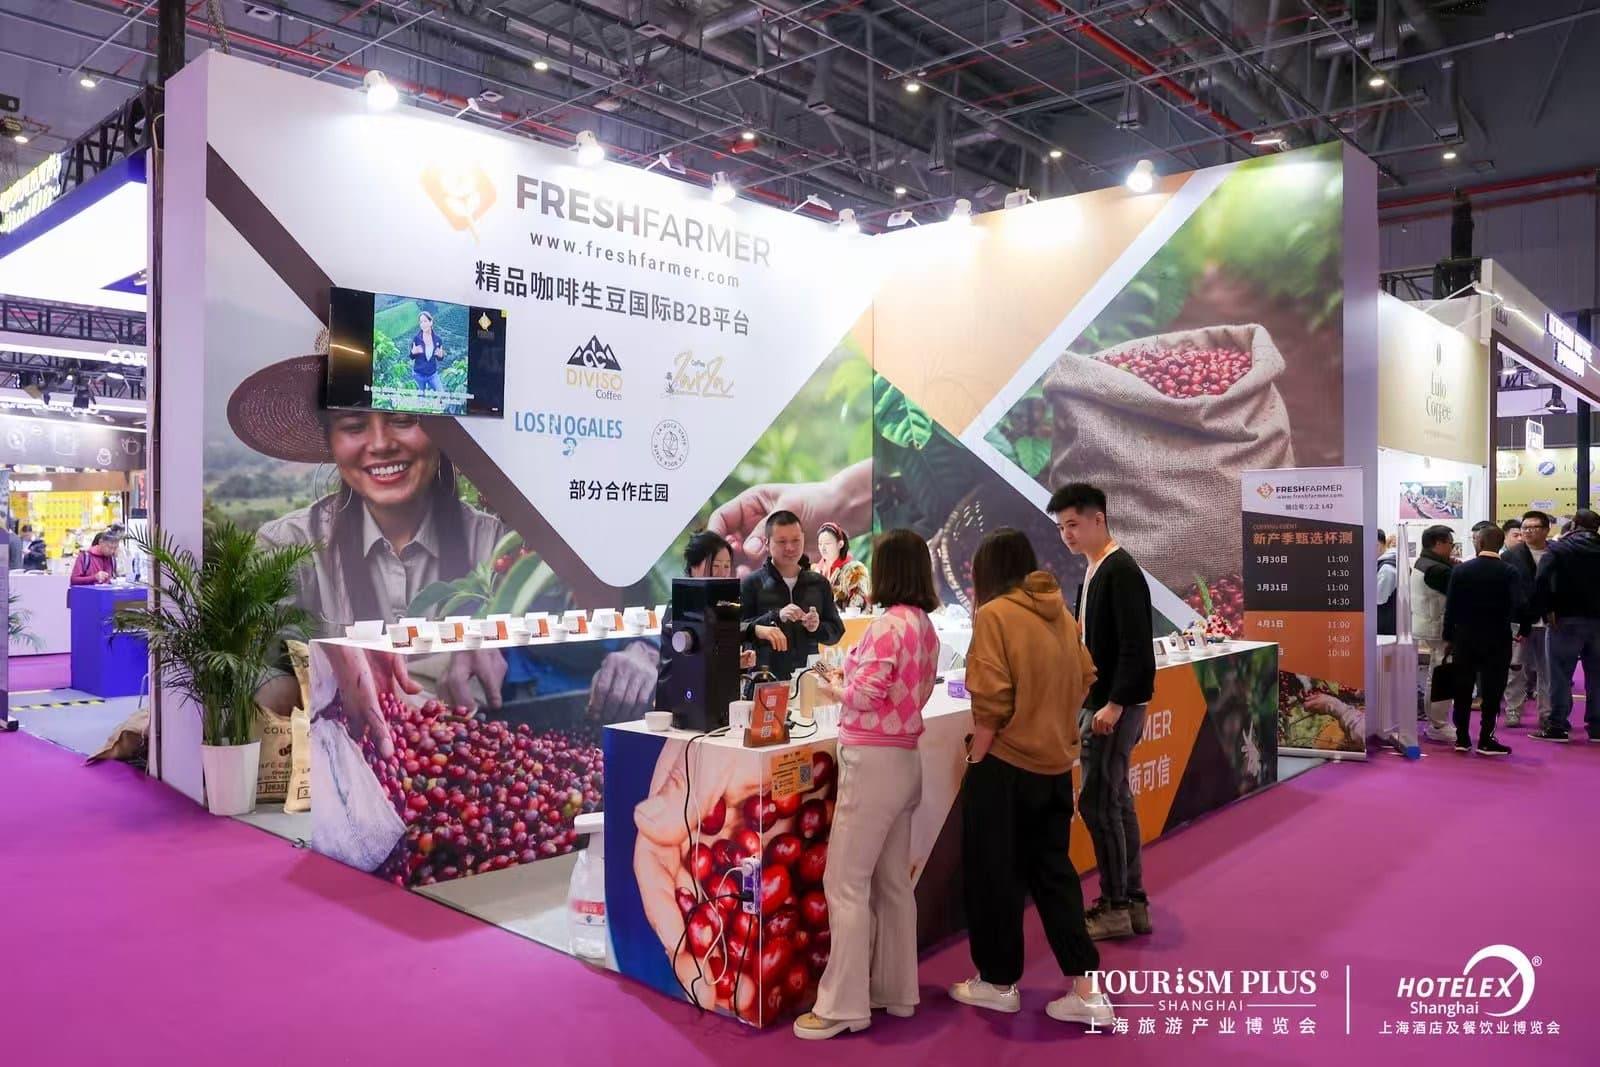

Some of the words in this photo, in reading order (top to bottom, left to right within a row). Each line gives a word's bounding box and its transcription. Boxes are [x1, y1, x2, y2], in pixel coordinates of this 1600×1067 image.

[515, 172, 771, 268] FRESHFARMER
[529, 231, 740, 289] www.freshfarmer.com
[474, 259, 750, 337] 精品咖啡生豆国际B2B平台
[566, 367, 624, 392] DIVISO
[595, 388, 623, 401] Coffee
[1425, 395, 1454, 425] Coffee
[514, 410, 546, 434] LOS
[549, 413, 624, 440] NOGALES
[568, 479, 670, 503] 部分合作庄园
[1275, 484, 1342, 494] FRESHFARMER
[1252, 530, 1353, 545] 新产季甄选杯测
[1256, 555, 1288, 564] 3月30日
[1327, 554, 1349, 563] 11:00
[1327, 569, 1350, 577] 14:30
[1256, 583, 1288, 592] 3月31日
[1327, 583, 1349, 591] 11:00
[1327, 597, 1350, 606] 14:30
[1256, 619, 1284, 628] 4月1日
[1327, 620, 1351, 629] 11:00
[1327, 634, 1350, 643] 14:30
